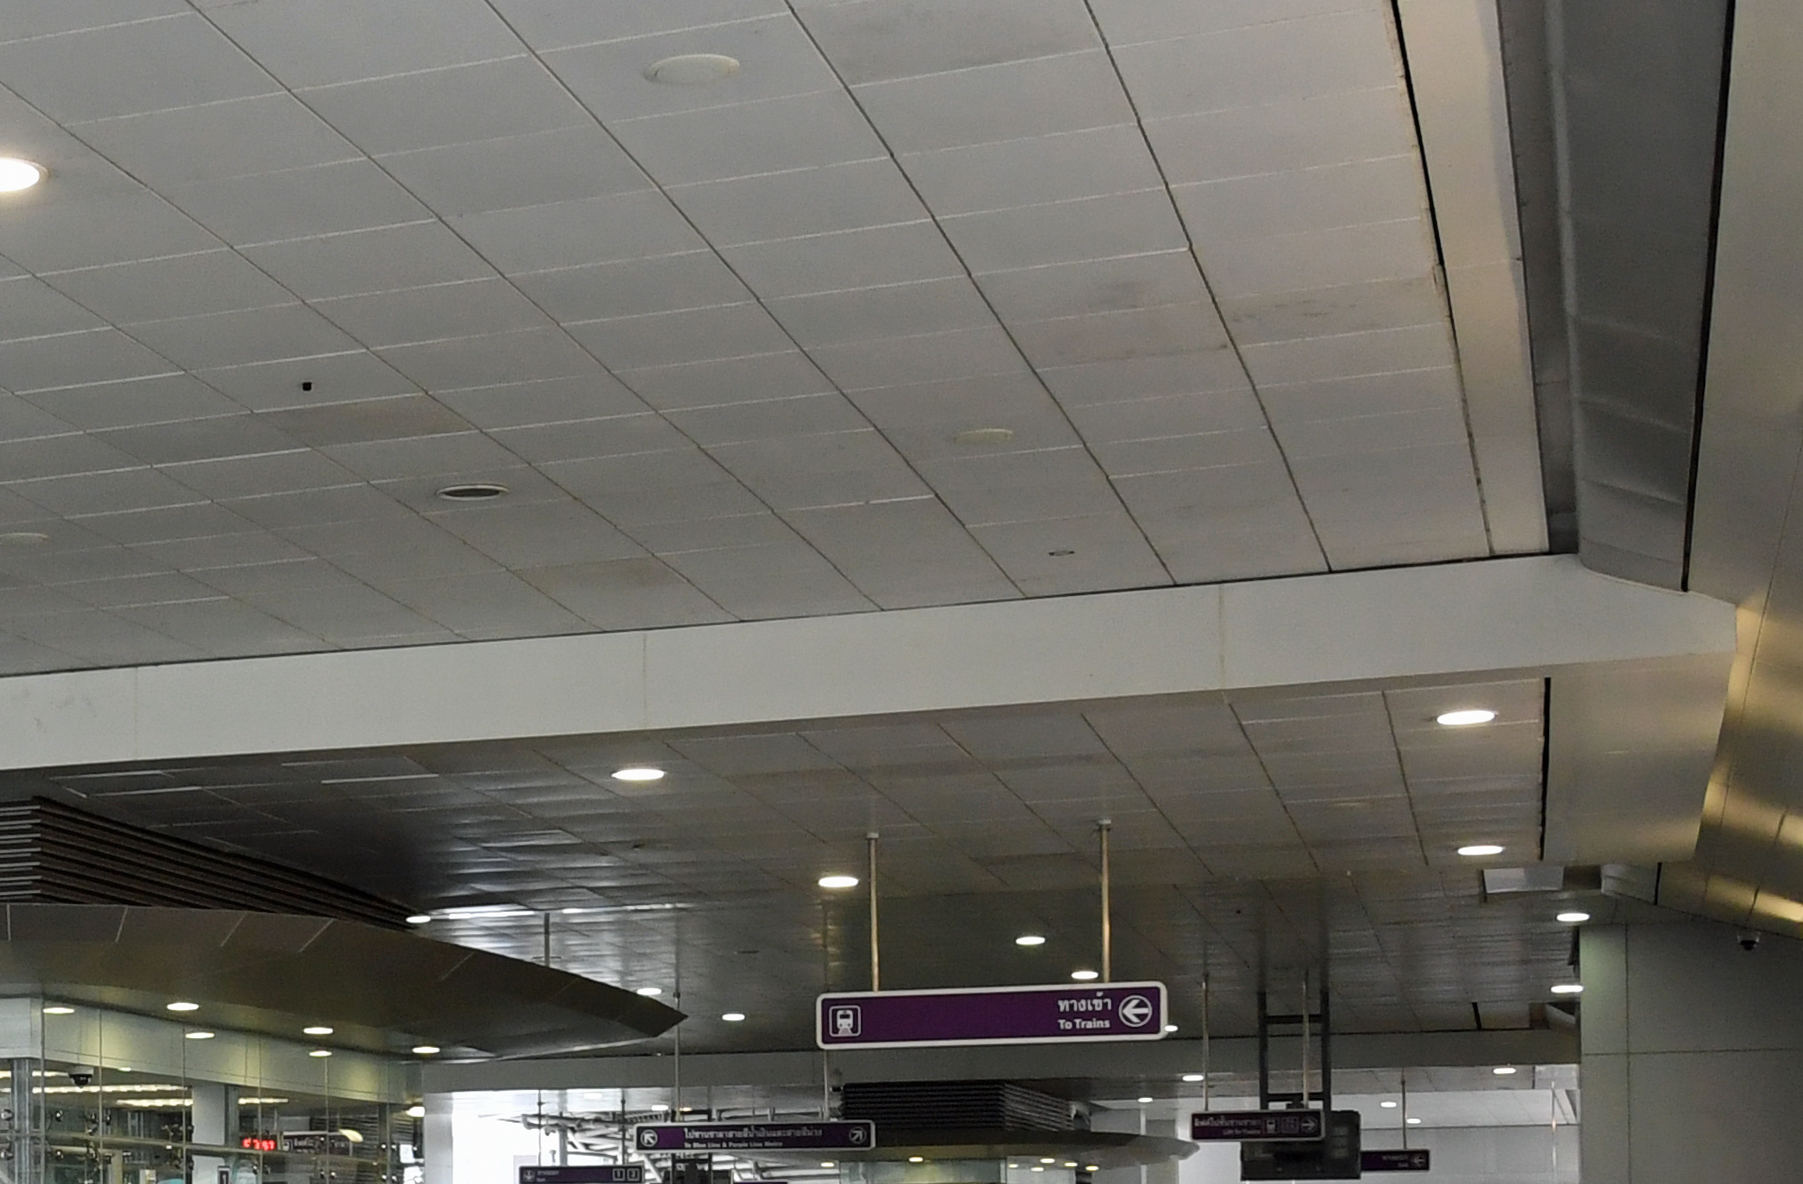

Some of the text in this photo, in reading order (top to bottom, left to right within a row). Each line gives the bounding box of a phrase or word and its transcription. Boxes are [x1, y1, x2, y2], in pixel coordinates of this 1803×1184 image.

[1057, 991, 1112, 1012] ทางเข้า
[1057, 1017, 1111, 1030] To Trains
